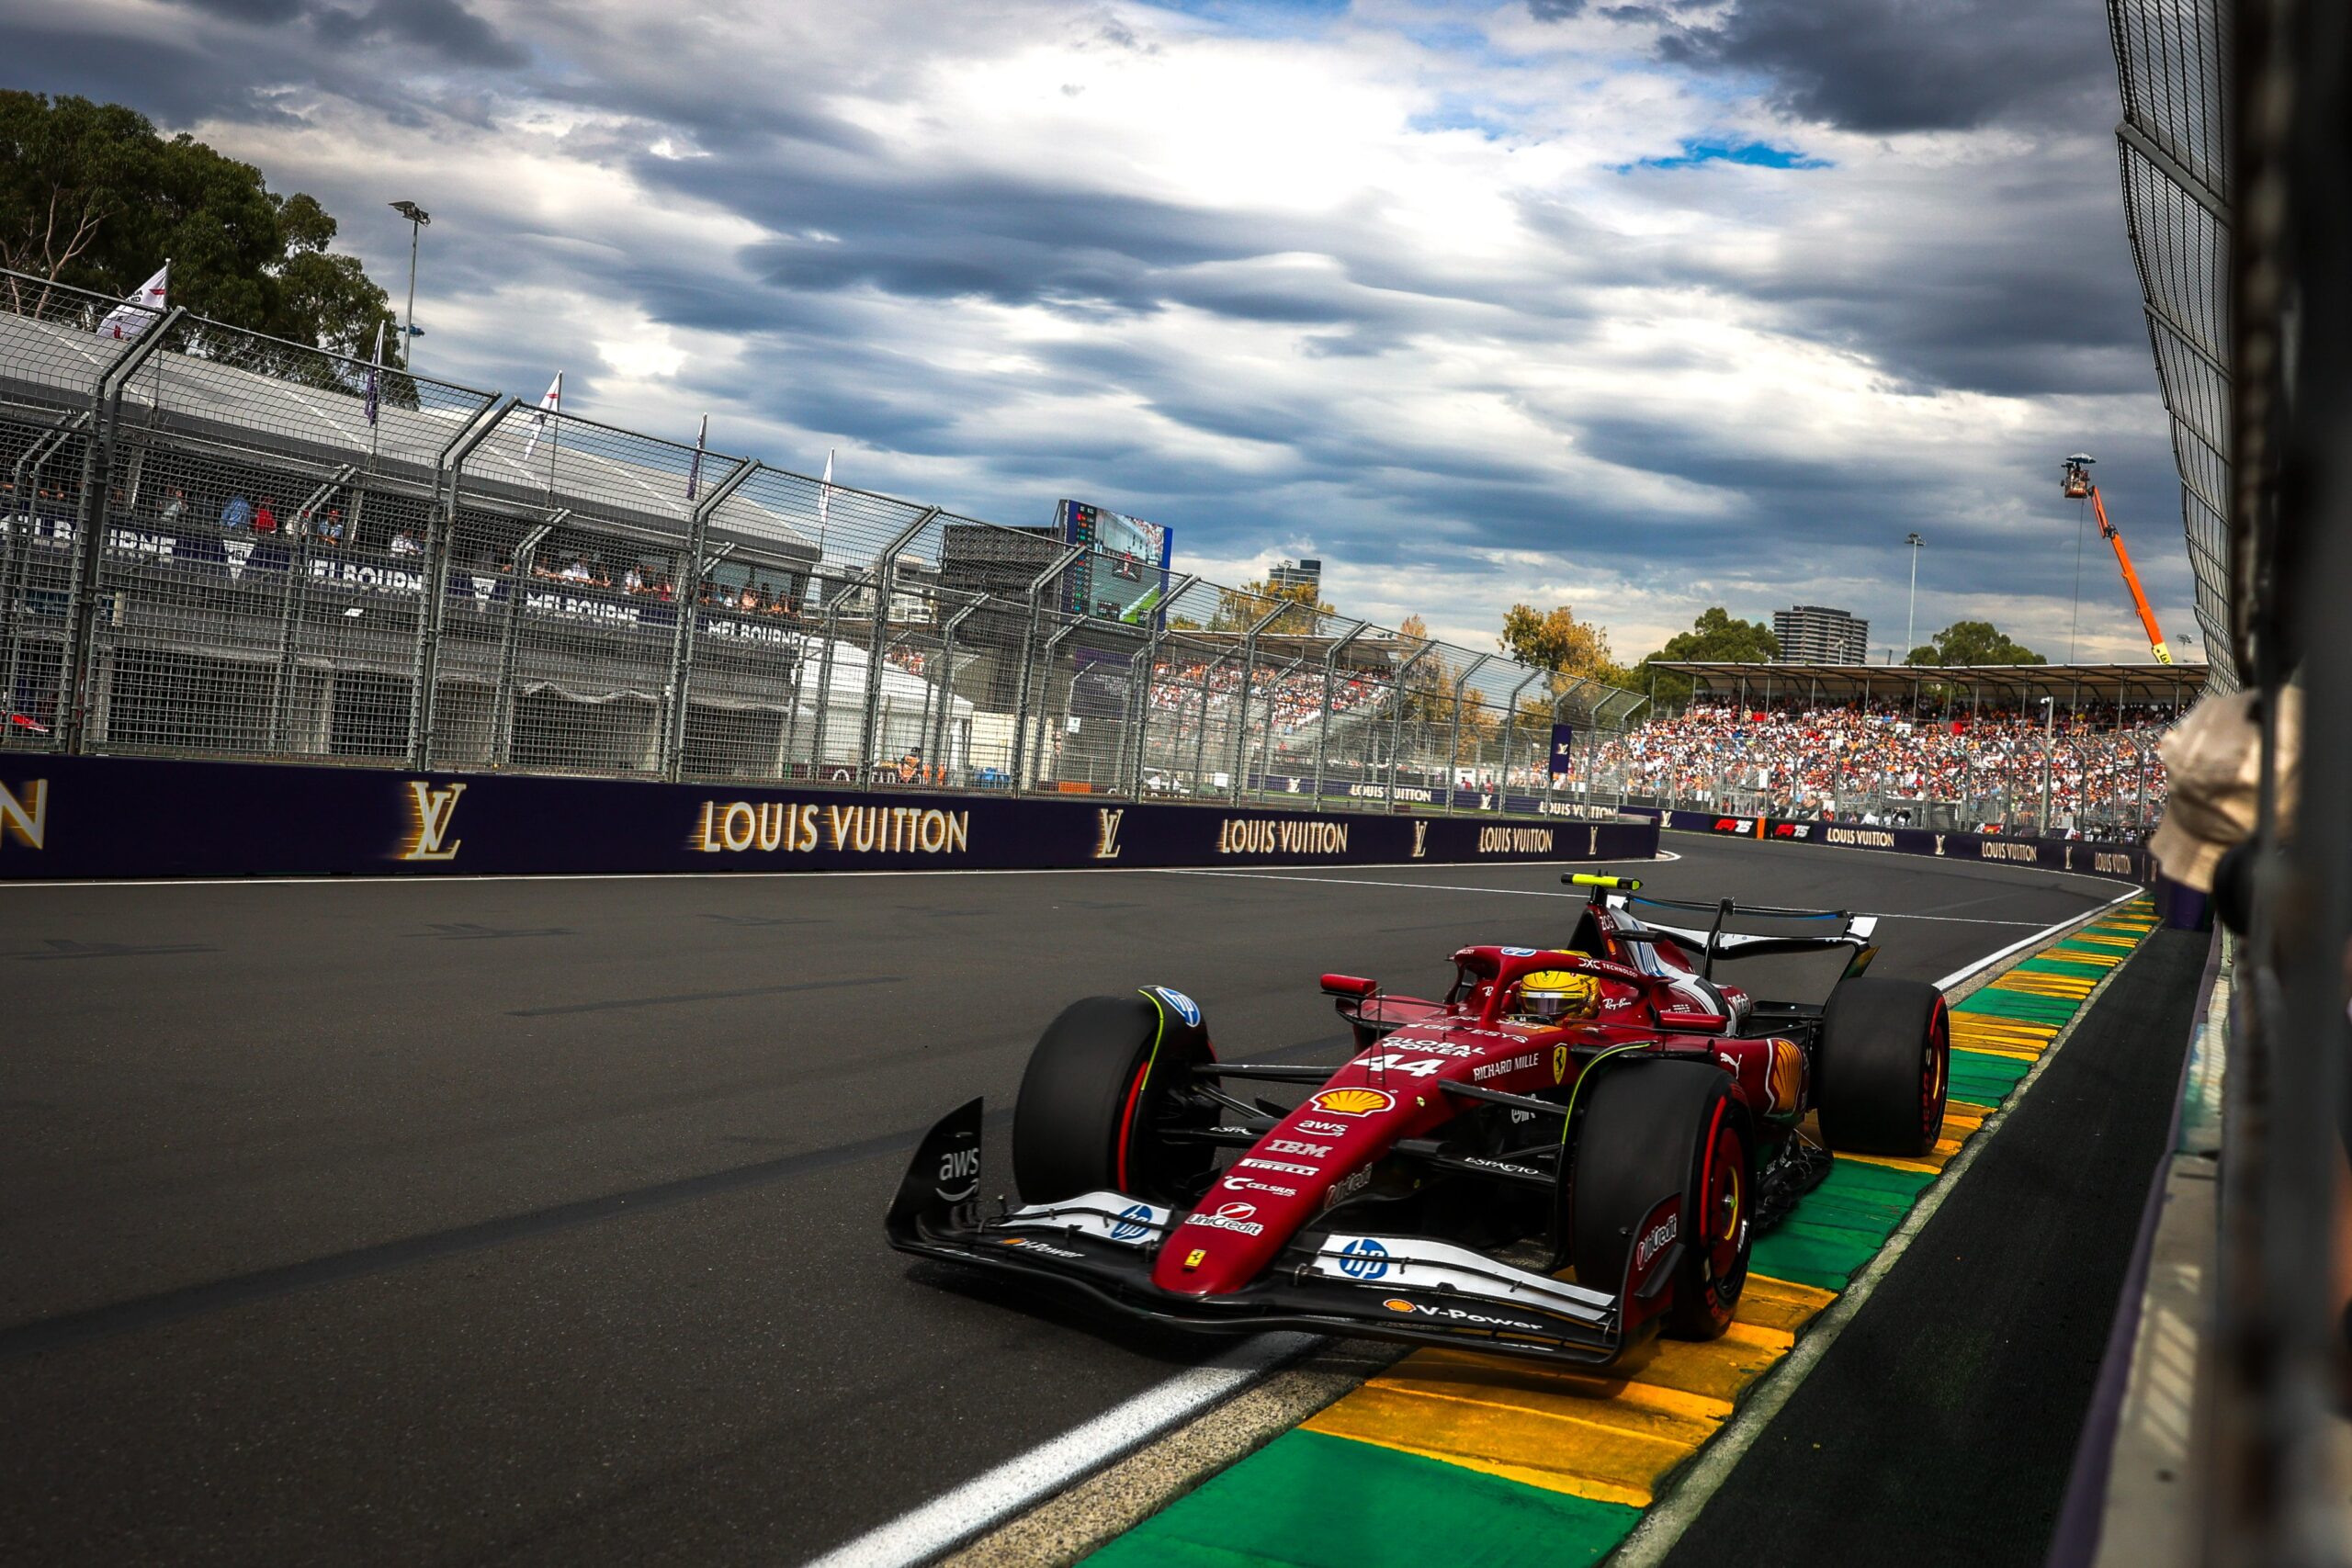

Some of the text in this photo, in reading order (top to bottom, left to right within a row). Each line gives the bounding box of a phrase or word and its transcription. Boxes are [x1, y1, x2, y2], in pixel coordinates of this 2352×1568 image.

[405, 781, 467, 861] LV
[702, 800, 969, 854] LOUIS VUITTON
[1097, 808, 1124, 859] LV
[1221, 818, 1349, 854] LOUIS VUITTON
[1479, 826, 1554, 853] LOUIS VUITTON
[1826, 827, 1895, 848] LOUIS VUITTON
[1981, 840, 2038, 863] LOUIS VUITTON
[2094, 852, 2112, 874] LOUIS
[1578, 957, 1601, 970] DXC
[1602, 997, 1632, 1010] Ray-Ban
[1382, 1036, 1486, 1055] GLOBAL
[1382, 1042, 1472, 1058] POKER
[1351, 1054, 1446, 1077] 44
[1472, 1052, 1539, 1082] RICHARD MILLE
[1297, 1120, 1349, 1133] aws
[1264, 1139, 1333, 1158] IBM
[939, 1147, 979, 1181] aws
[1238, 1157, 1320, 1177] PIRELLI
[1184, 1213, 1264, 1236] UniCredit
[1340, 1238, 1389, 1280] hp
[1415, 1303, 1544, 1331] V-Power
